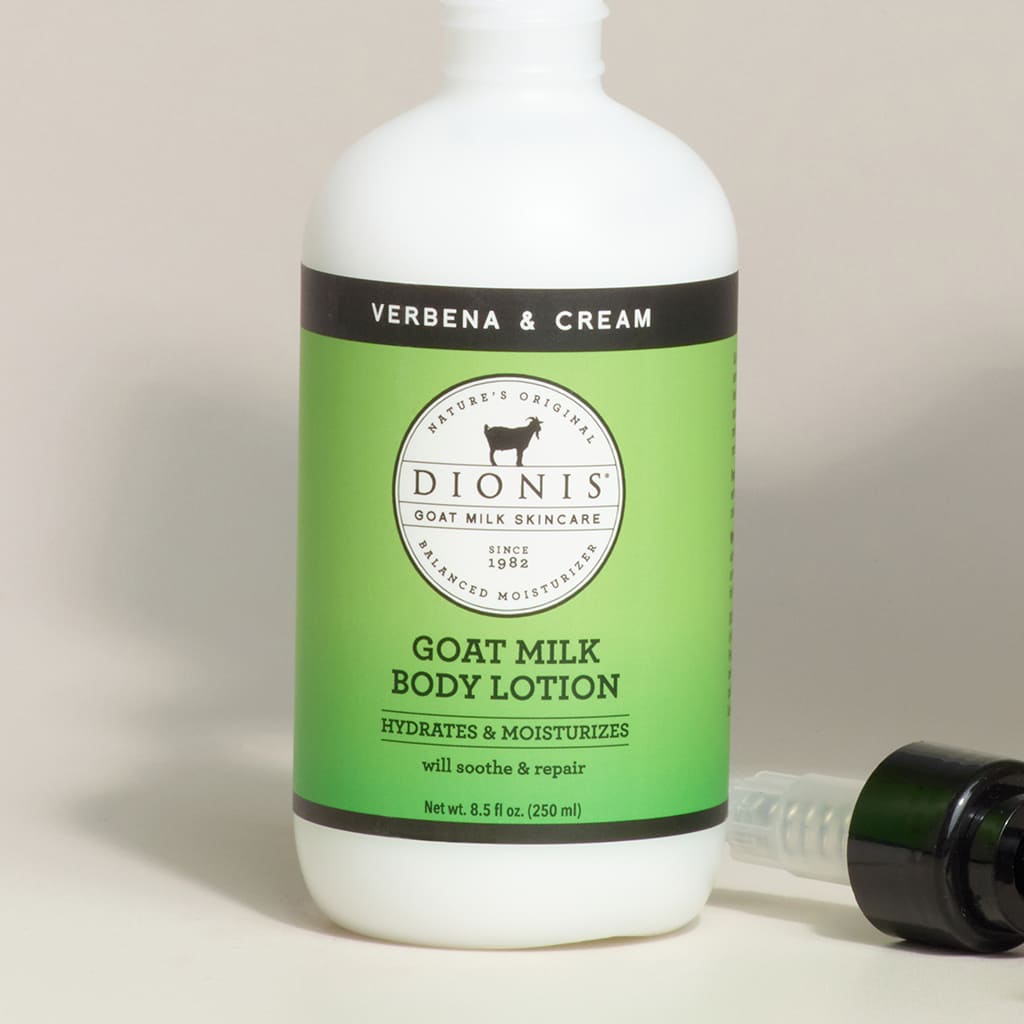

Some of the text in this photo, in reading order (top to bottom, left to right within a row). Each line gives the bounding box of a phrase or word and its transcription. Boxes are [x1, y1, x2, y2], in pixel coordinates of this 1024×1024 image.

[371, 303, 652, 331] VERBENA & CREAM
[428, 390, 595, 444] NATURE'S ORIGINAL
[414, 510, 601, 525] GOAT MILK SKINCARE
[488, 545, 529, 555] SINCE
[418, 539, 597, 601] BALANCED MOISTURIZER
[488, 556, 529, 569] 1982
[412, 635, 600, 664] GOAT MILK
[392, 669, 620, 701] BODY LOTION
[381, 717, 629, 741] HYDRATES & MOISTURIZES
[422, 757, 586, 779] will soothe & repair
[424, 800, 582, 820] Net wt. 8.5 fl oz. (250 ml)
